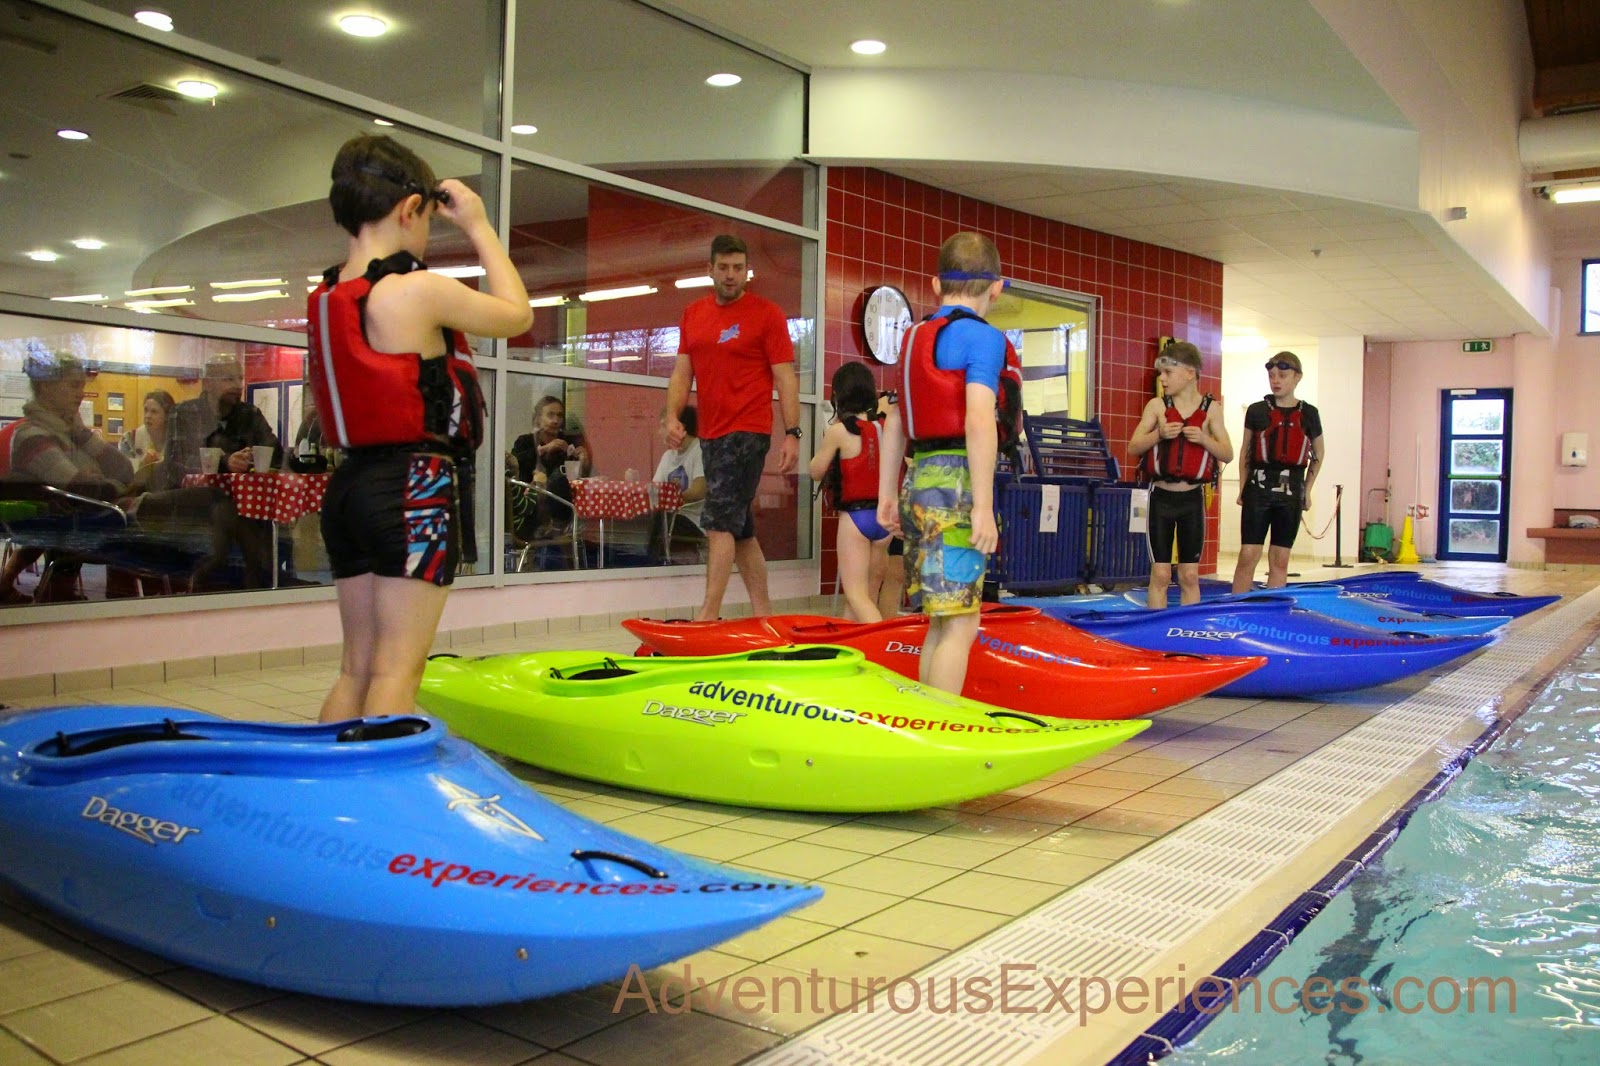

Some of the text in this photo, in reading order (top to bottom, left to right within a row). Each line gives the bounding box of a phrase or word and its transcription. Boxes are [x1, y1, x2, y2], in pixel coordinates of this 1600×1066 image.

[869, 304, 878, 314] 10
[866, 317, 872, 327] 9
[1166, 627, 1248, 642] Dagger
[885, 641, 922, 655] Dag
[641, 700, 747, 727] Dagger
[81, 796, 200, 847] Dagger
